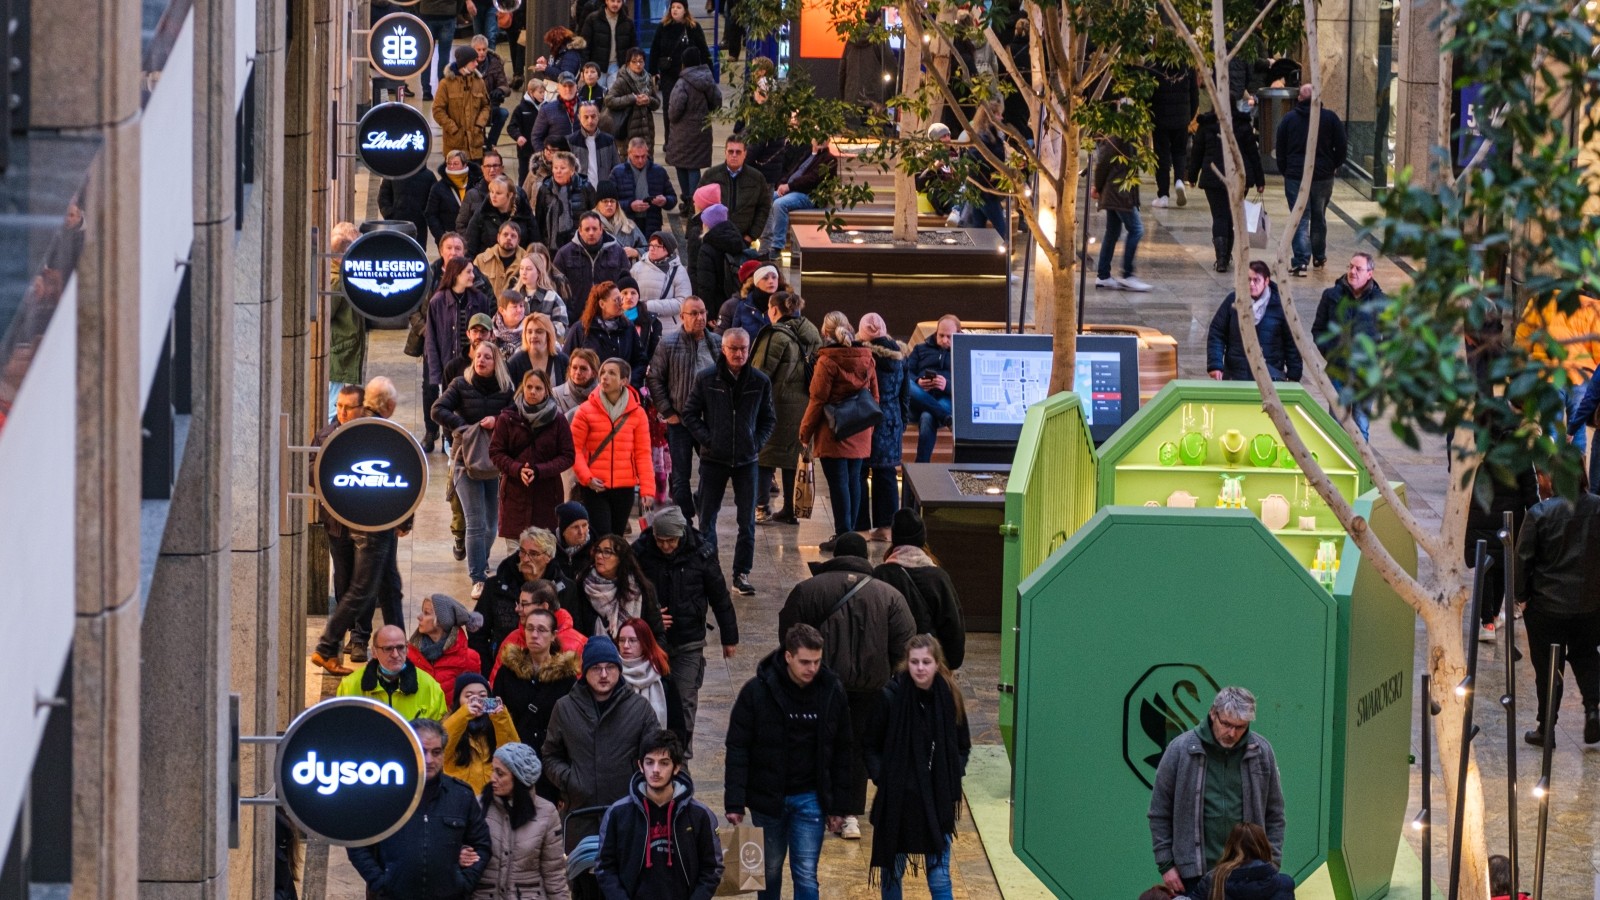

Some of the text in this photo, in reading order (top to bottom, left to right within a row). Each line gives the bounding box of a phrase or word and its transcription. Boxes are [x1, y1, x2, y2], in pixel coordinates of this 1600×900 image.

[361, 131, 413, 150] Lindt
[344, 260, 425, 272] PME LEGEND
[1356, 670, 1403, 728] SWAROVSKI
[292, 751, 405, 795] dyson
